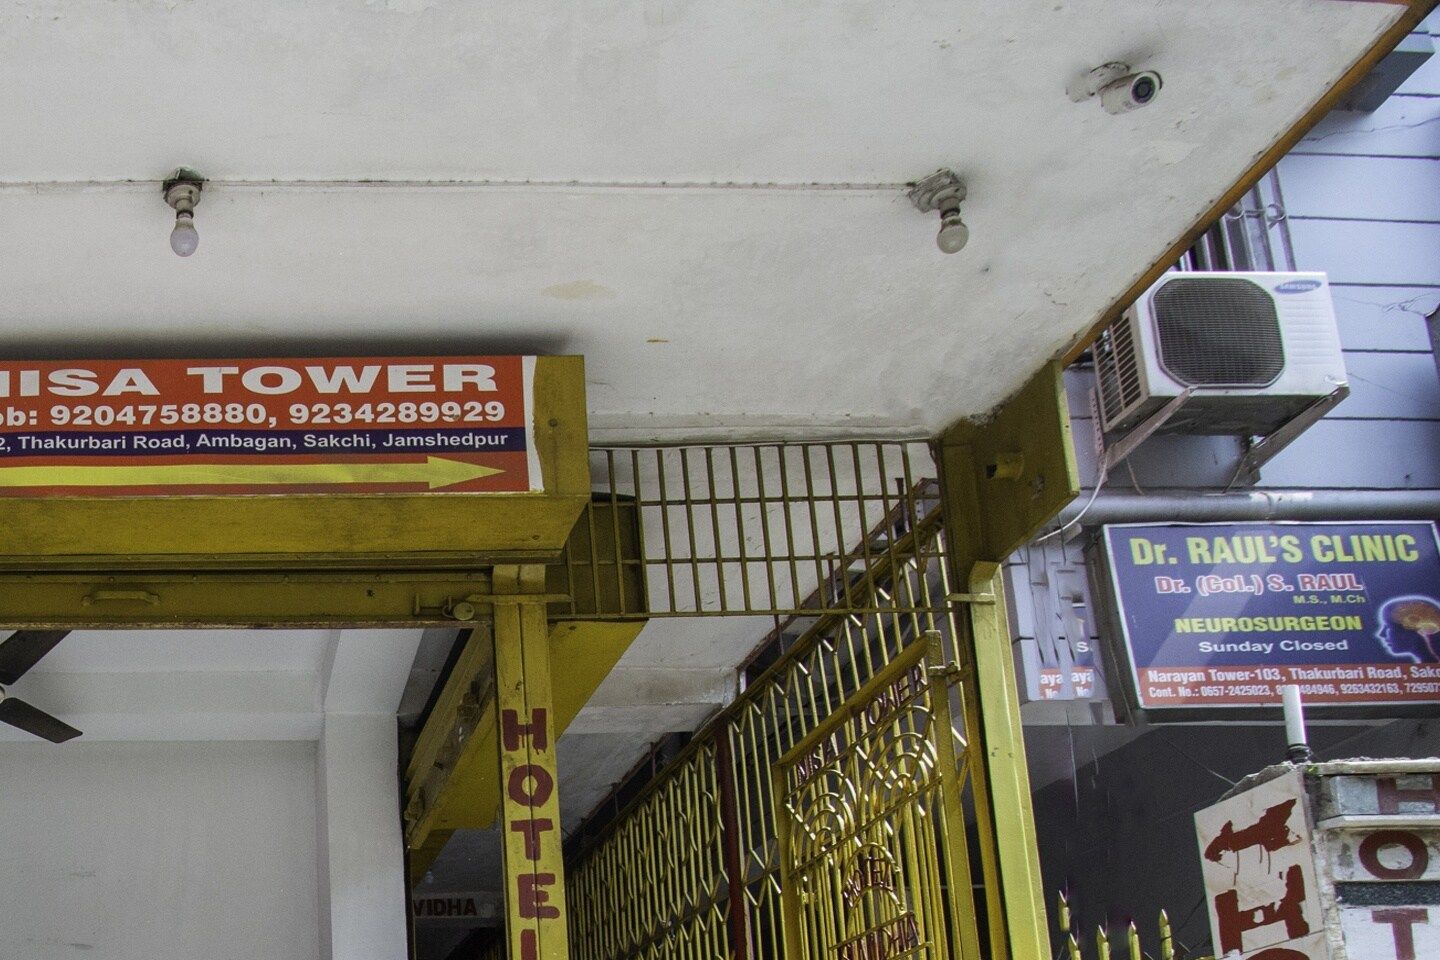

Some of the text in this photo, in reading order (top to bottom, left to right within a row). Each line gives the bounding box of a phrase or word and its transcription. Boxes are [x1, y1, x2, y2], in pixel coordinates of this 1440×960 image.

[187, 363, 498, 395] TOWER
[50, 402, 277, 429] 9204758880,
[289, 400, 506, 424] 9234289929
[18, 434, 127, 452] Thakurbari
[133, 433, 190, 451] Road,
[196, 432, 293, 452] Ambagan,
[303, 431, 375, 451] Sakchi,
[382, 430, 508, 451] Jamshedpur
[1130, 533, 1419, 565] Dr. RAUL'S CLINIC
[1154, 572, 1364, 596] Dr. (Col.) S. RAUL
[1330, 593, 1366, 604] M.Ch
[1174, 616, 1363, 634] NEUROSURGEON
[1199, 639, 1349, 655] Sunday Closed
[1148, 669, 1205, 685] Narayan
[1208, 668, 1286, 683] Tower-103,
[1289, 666, 1363, 681] Thakurbari
[1367, 665, 1408, 680] Road,
[1149, 686, 1176, 698] Cont.
